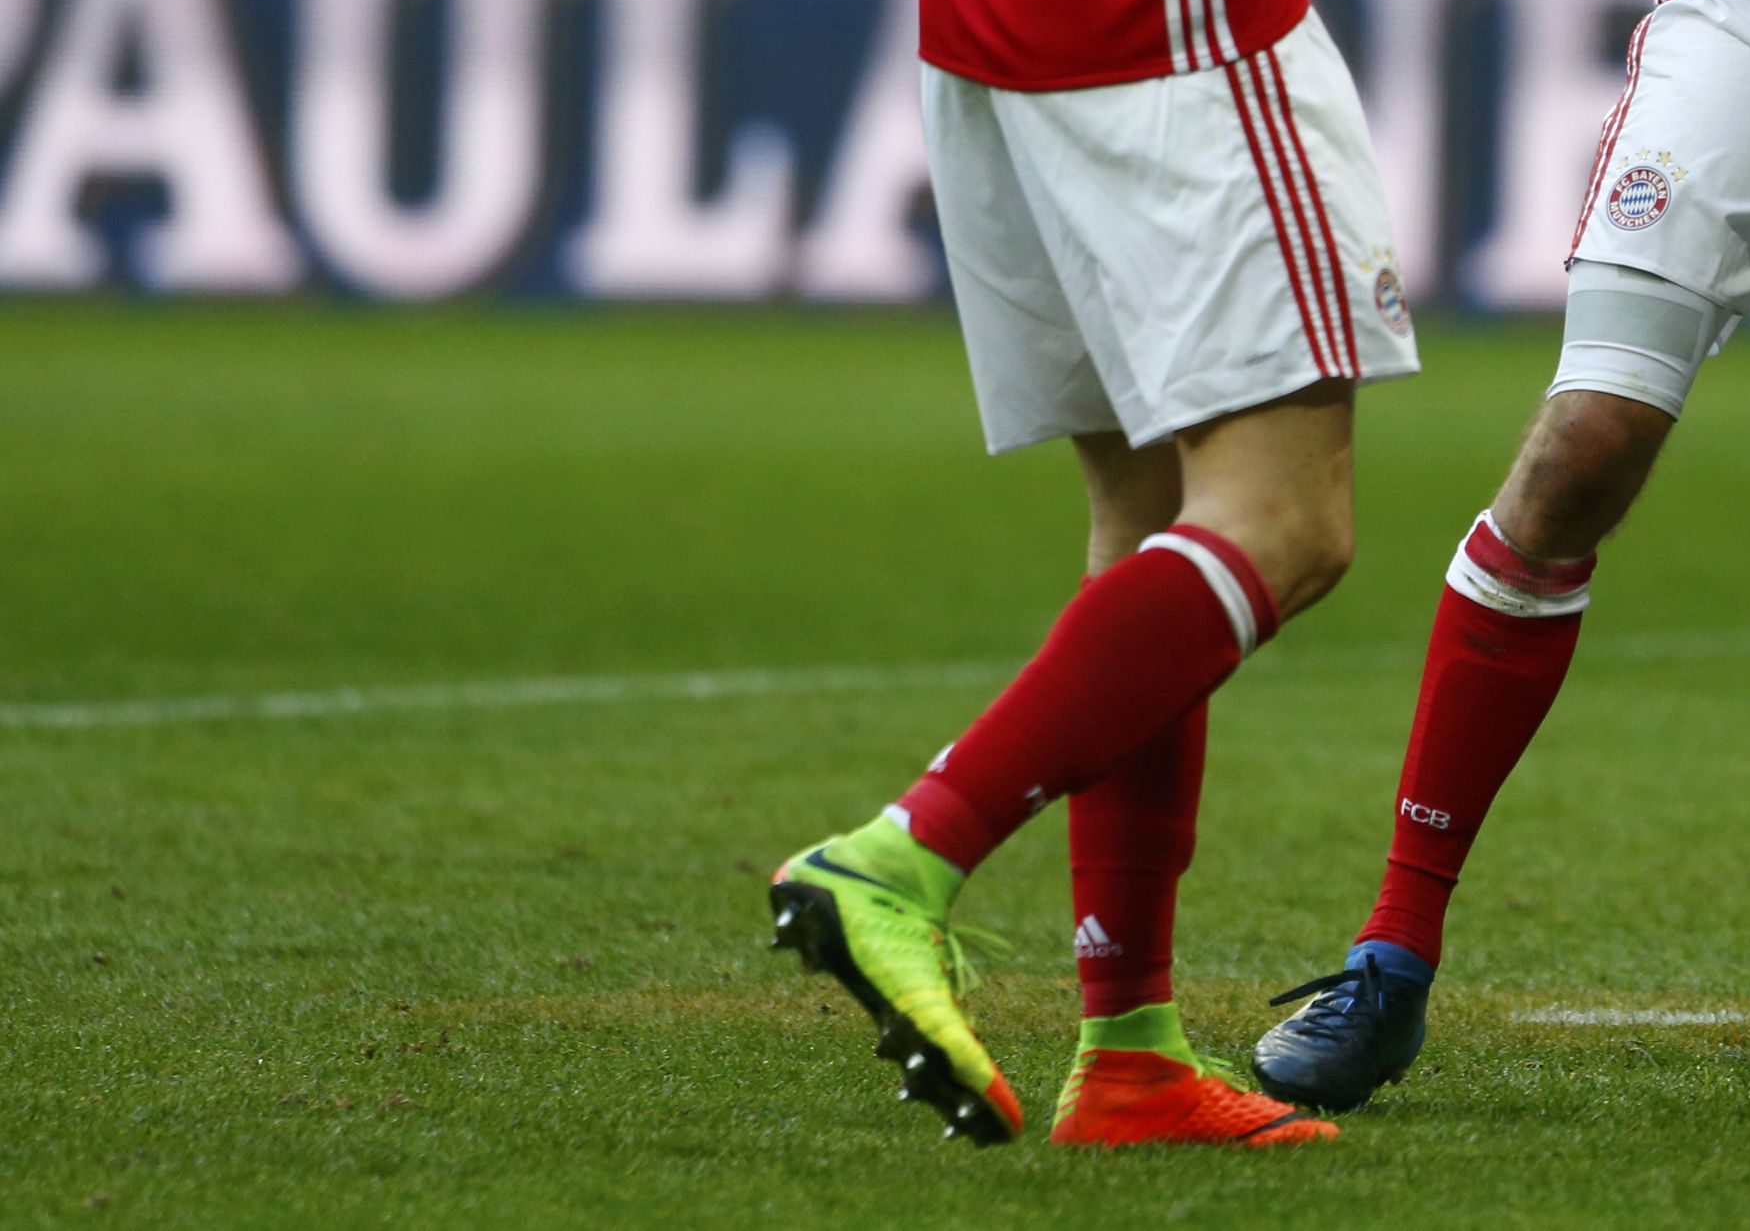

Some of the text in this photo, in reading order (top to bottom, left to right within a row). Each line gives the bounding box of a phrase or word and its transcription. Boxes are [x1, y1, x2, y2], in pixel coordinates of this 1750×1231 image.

[1616, 170, 1667, 200] FC BAYERN
[1400, 797, 1451, 829] FCB
